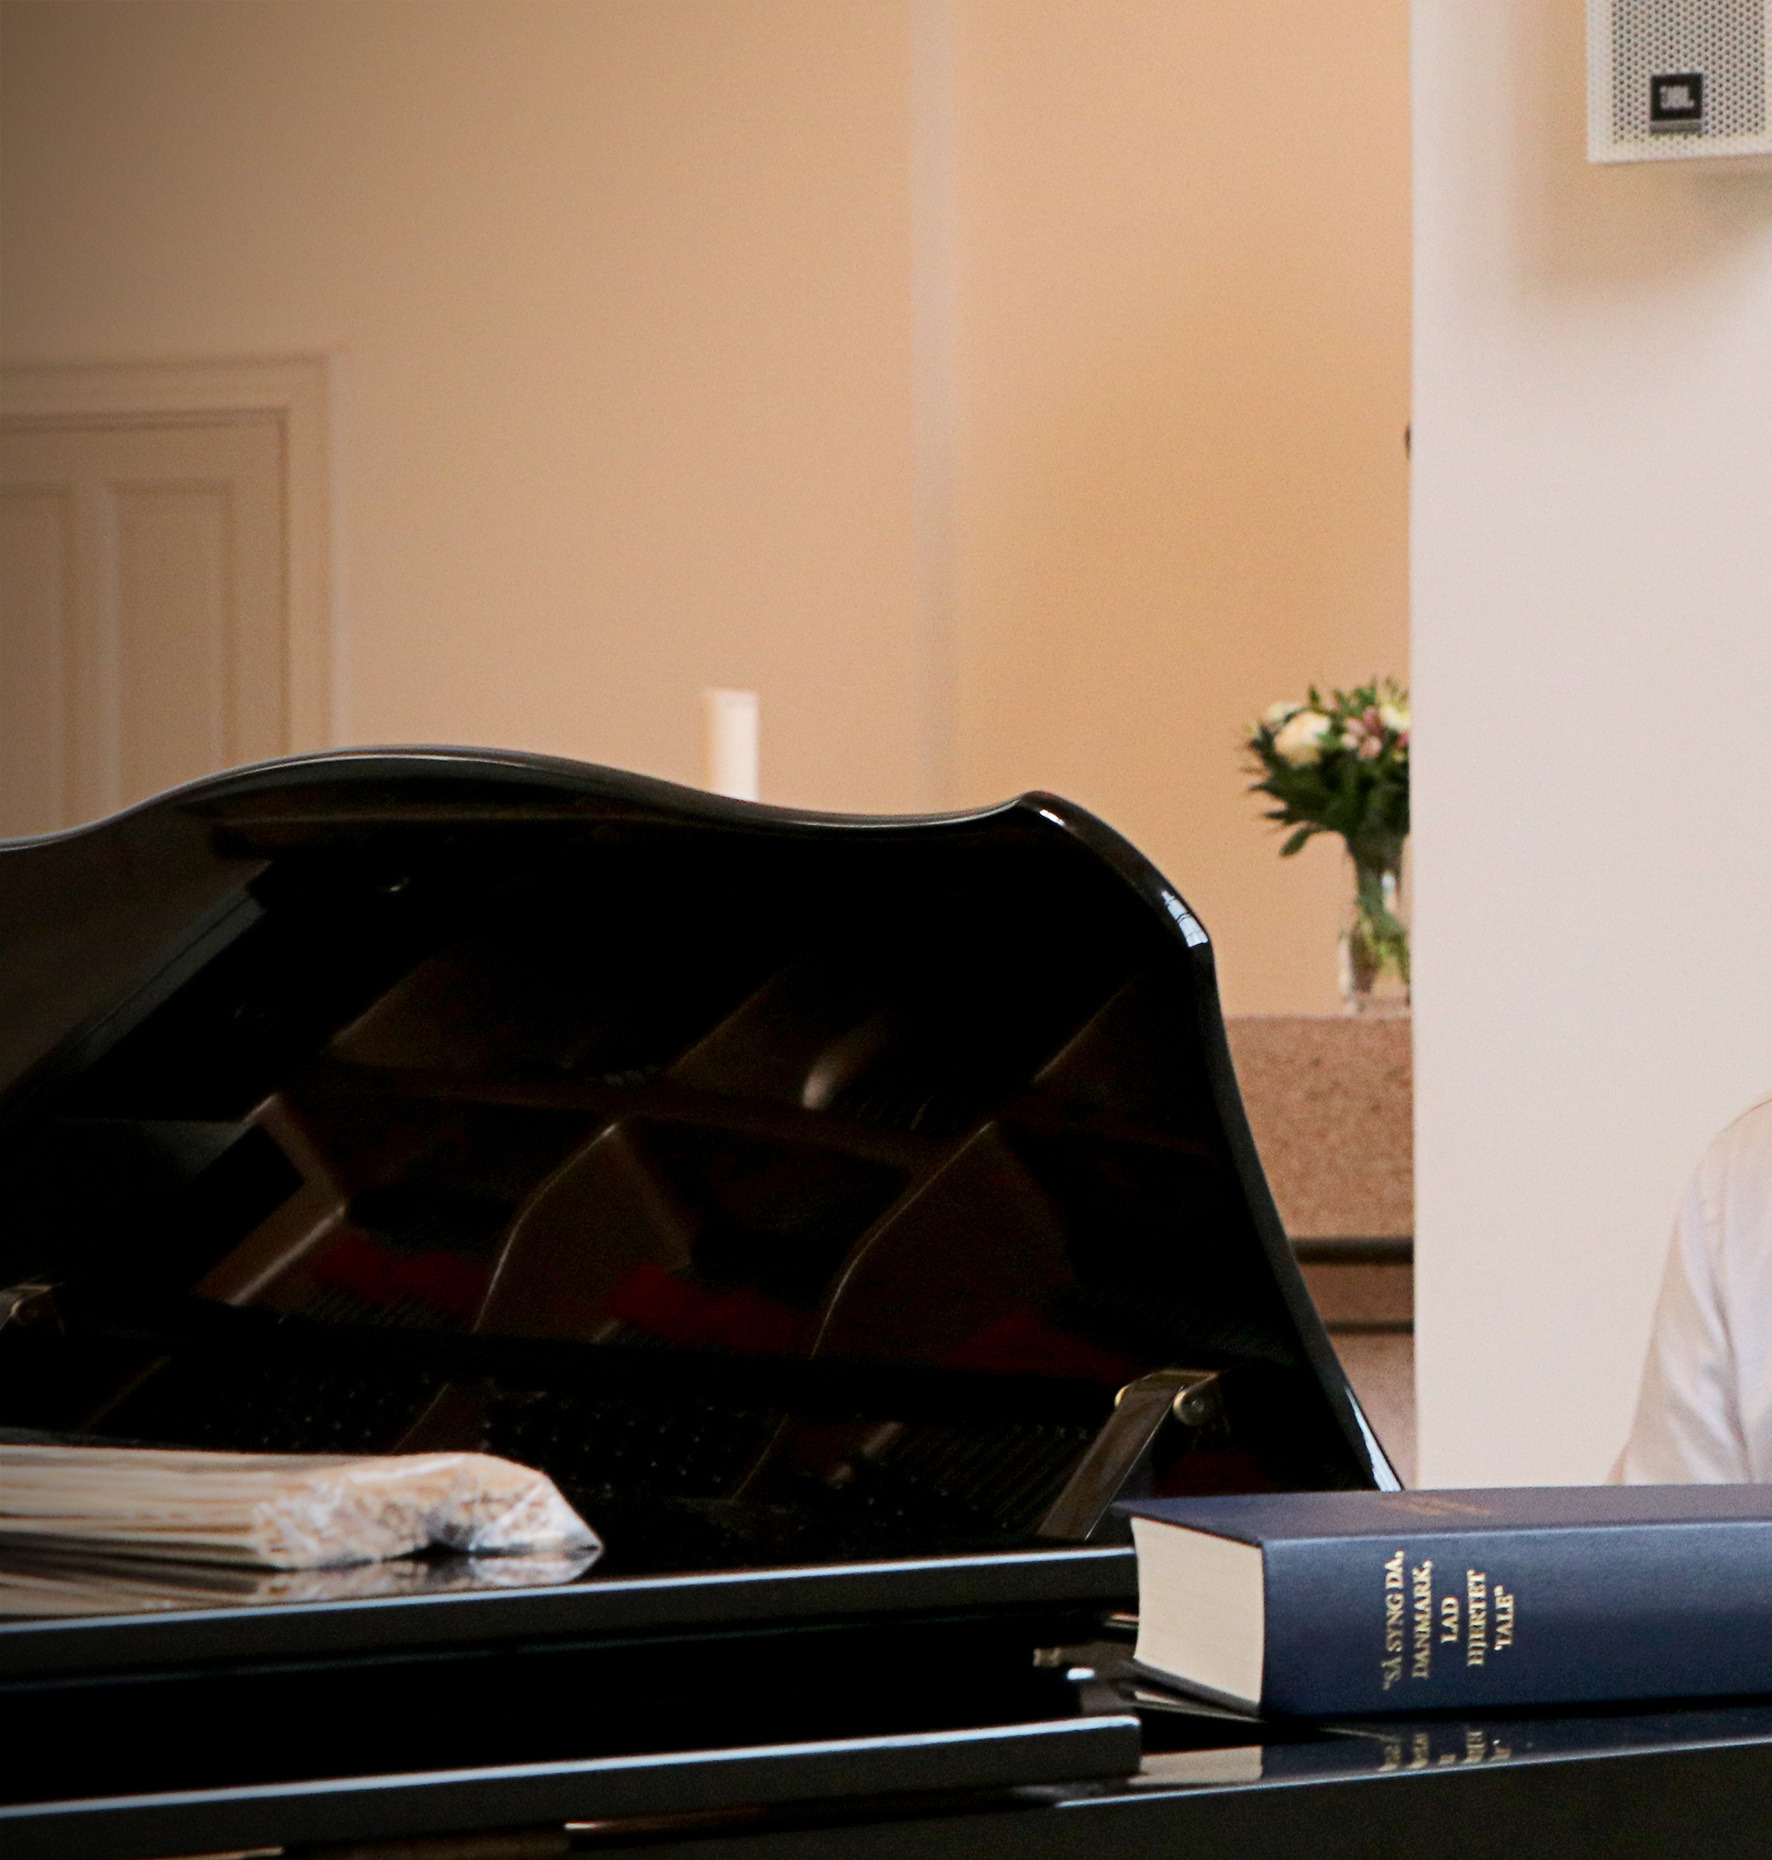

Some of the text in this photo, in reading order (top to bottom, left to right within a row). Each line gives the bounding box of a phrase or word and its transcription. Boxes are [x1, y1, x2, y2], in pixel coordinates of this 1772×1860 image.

[1385, 1593, 1405, 1653] SYNG
[1411, 1560, 1433, 1679] DANMARK,
[1440, 1596, 1460, 1644] LAD
[1466, 1569, 1489, 1667] HJERTET
